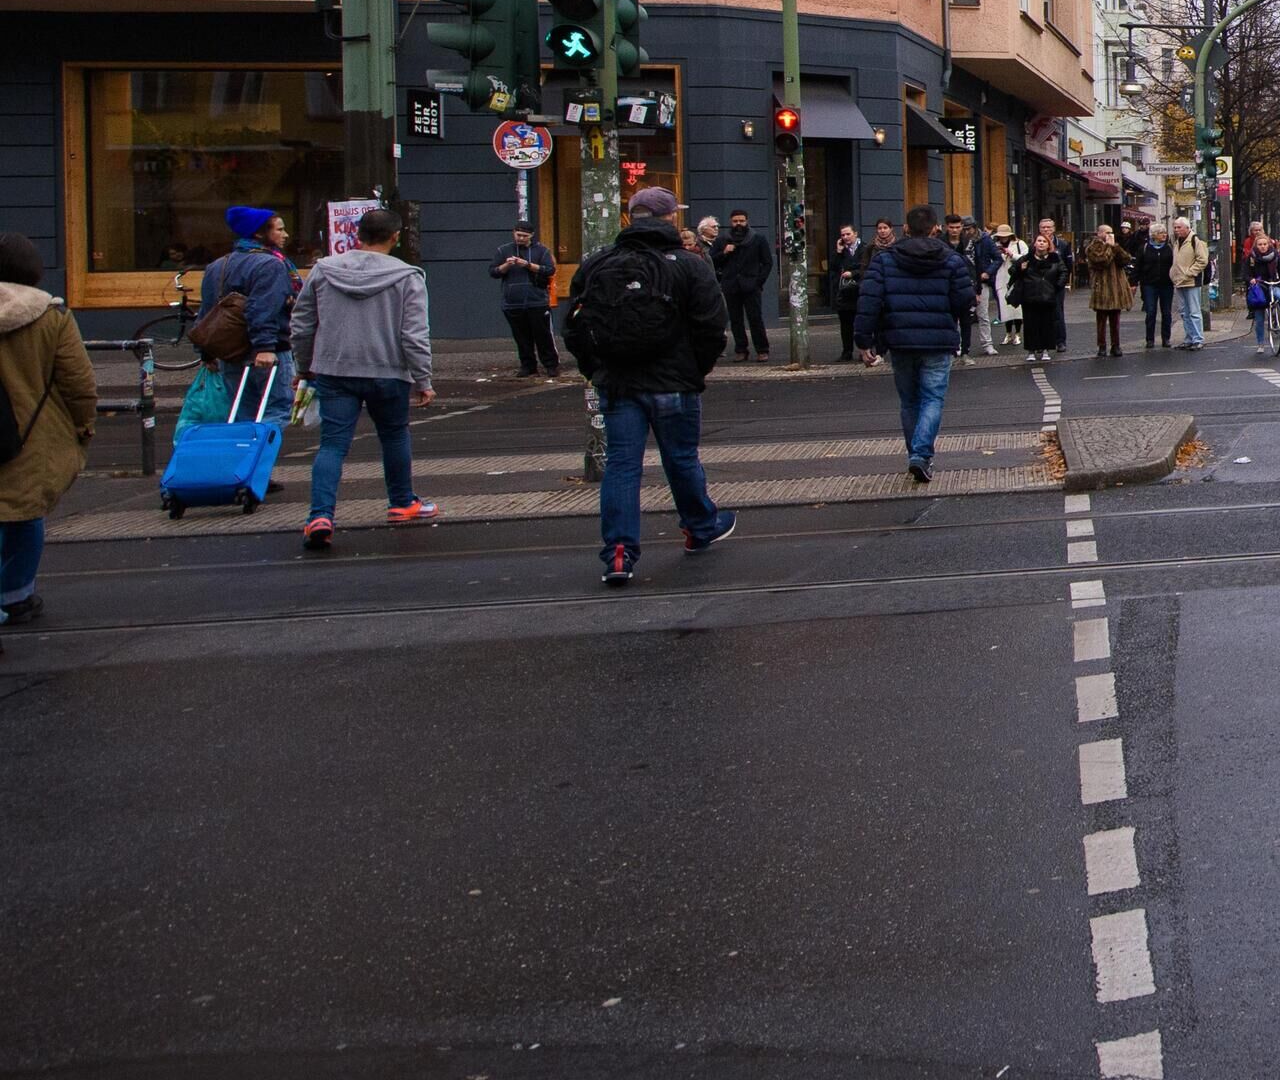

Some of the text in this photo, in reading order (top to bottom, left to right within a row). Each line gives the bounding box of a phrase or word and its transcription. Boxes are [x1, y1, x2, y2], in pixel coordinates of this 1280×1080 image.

[414, 101, 422, 133] ZEIT
[422, 107, 431, 134] FÜR
[430, 100, 438, 135] BROT
[965, 124, 976, 151] BROT
[1082, 158, 1120, 167] RIESEN
